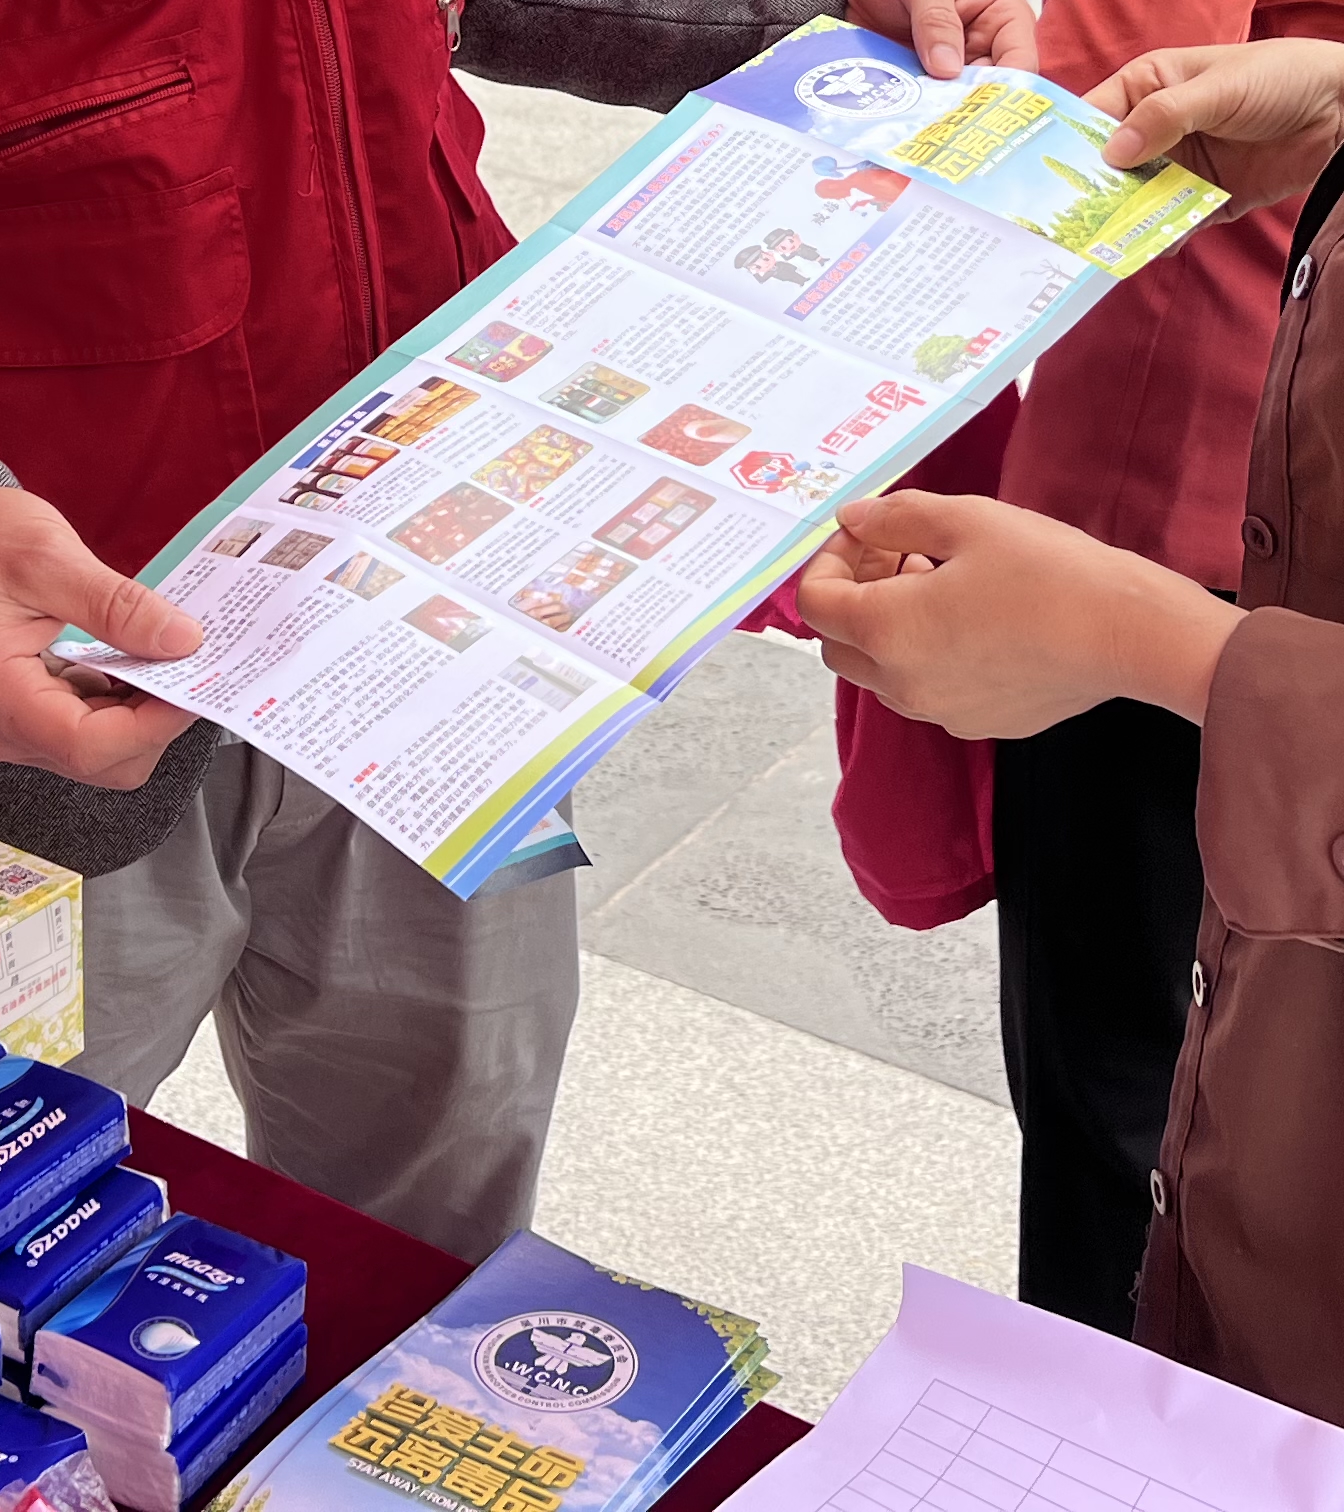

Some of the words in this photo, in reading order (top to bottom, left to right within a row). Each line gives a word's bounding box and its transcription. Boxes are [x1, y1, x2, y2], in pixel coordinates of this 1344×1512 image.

[920, 87, 1055, 184] 远离毒品
[366, 1381, 587, 1489] 珍爱生命
[517, 1393, 567, 1409] CONTROL
[328, 1411, 565, 1512] 远离毒品
[347, 1457, 382, 1478] STAY
[378, 1471, 422, 1494] AWAY
[418, 1489, 460, 1511] FROM
